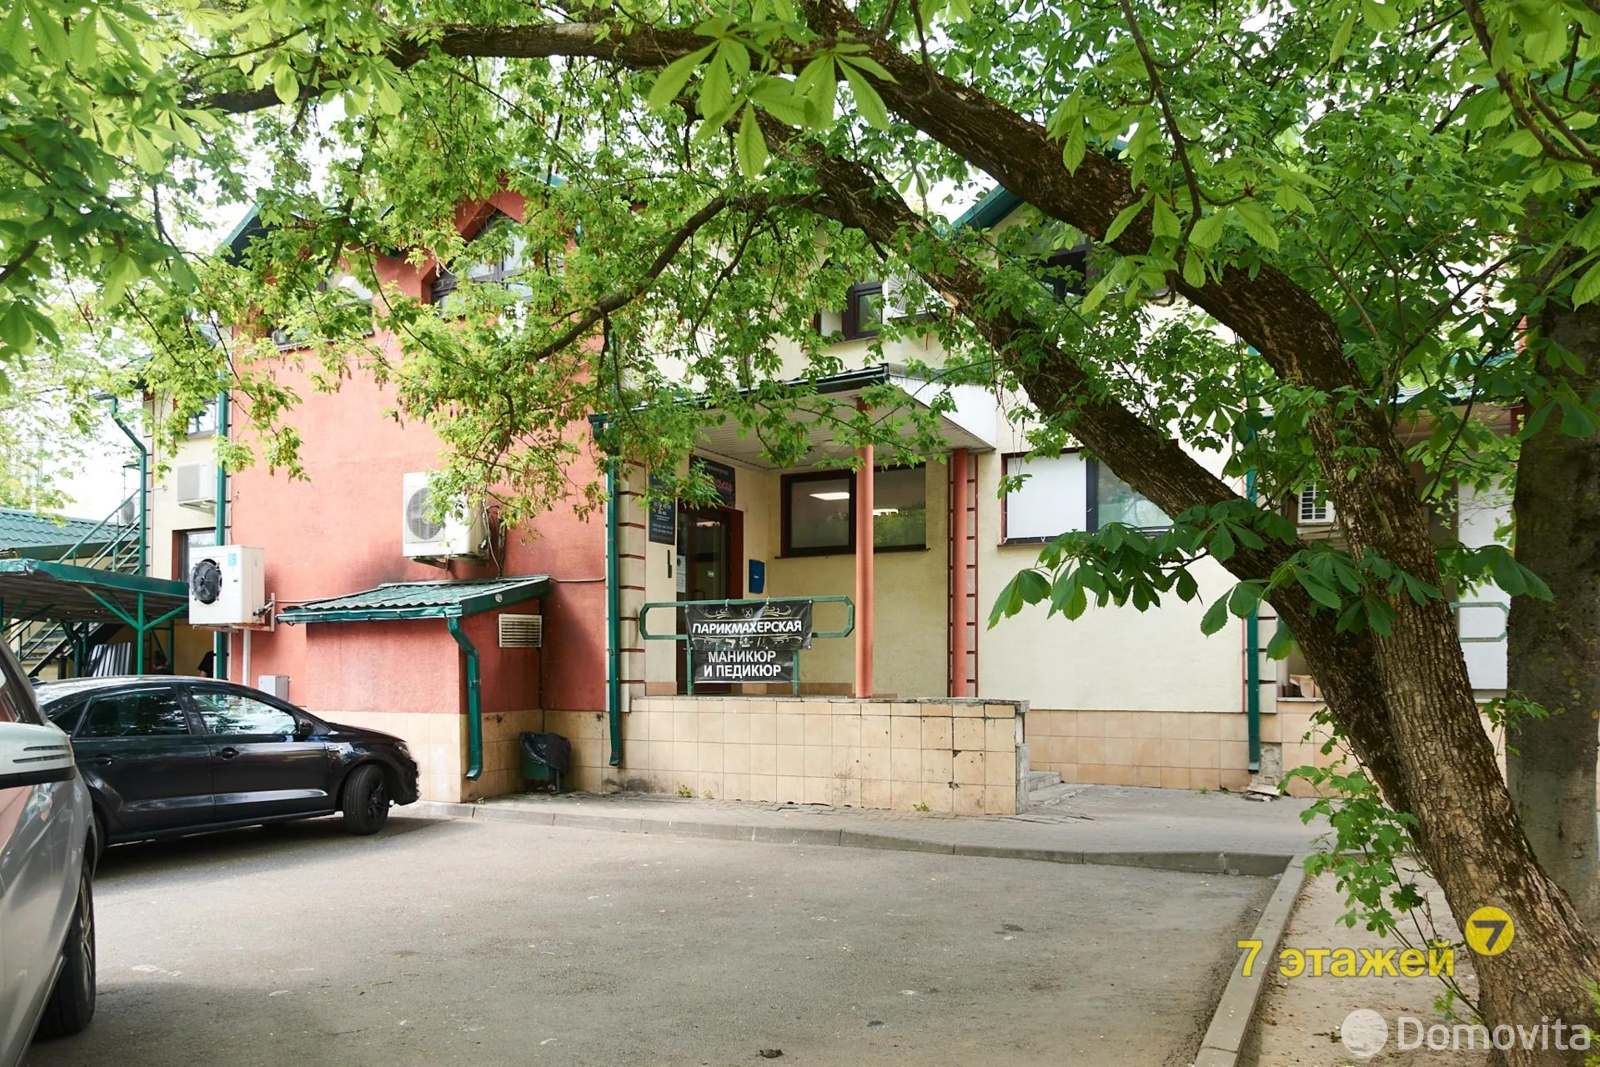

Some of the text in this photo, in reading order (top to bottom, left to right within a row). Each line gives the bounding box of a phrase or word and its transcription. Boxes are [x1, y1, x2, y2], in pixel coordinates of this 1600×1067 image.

[692, 620, 802, 634] ПАРИКМАХЕРСКАЯ
[708, 650, 776, 663] МАНИКЮР
[704, 664, 782, 679] И ПЕДИКЮР
